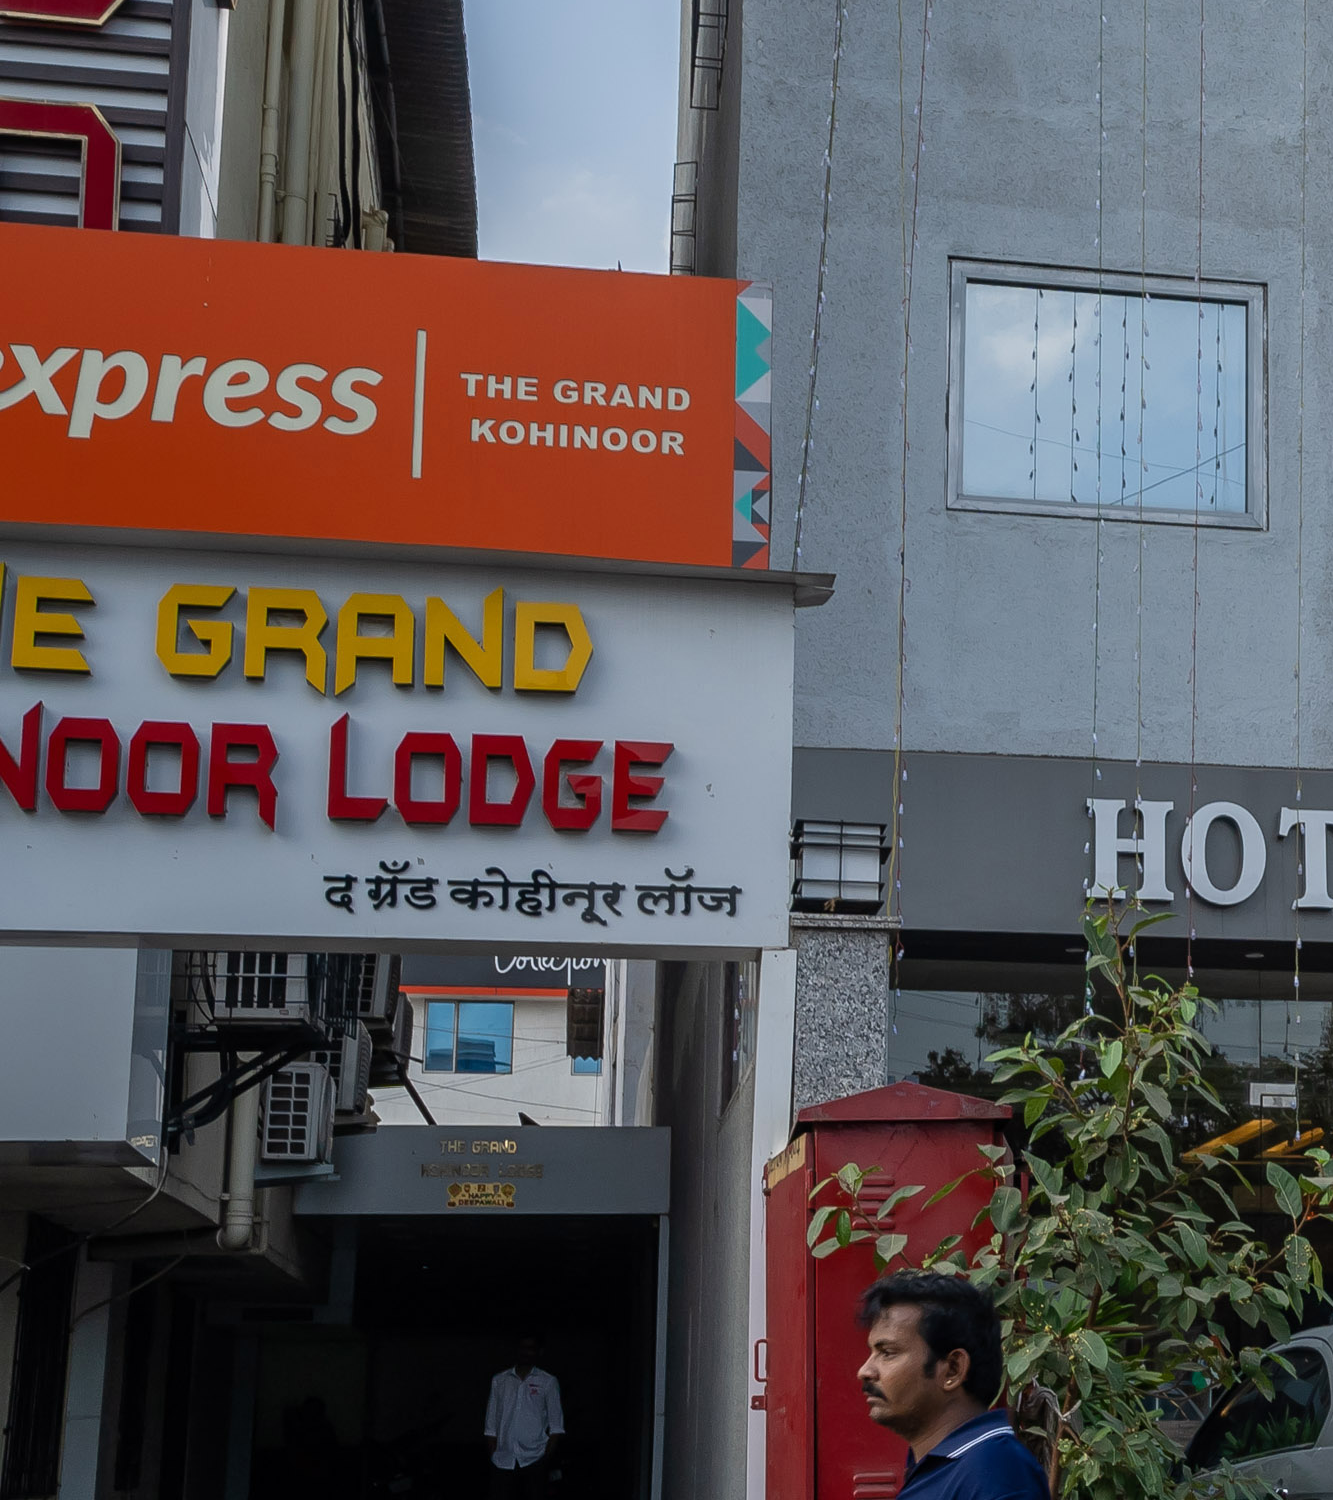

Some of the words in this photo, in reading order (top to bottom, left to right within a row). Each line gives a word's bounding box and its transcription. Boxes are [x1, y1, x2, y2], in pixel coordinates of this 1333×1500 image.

[460, 372, 539, 404] THE
[553, 379, 691, 413] GRAND
[469, 418, 686, 457] KOHINOOR
[155, 583, 595, 697] GRAND
[328, 712, 675, 834] LODGE
[322, 872, 358, 915] द
[447, 866, 626, 927] कोहीनूर
[635, 866, 743, 918] लॉज
[440, 1140, 466, 1154] THE
[471, 1140, 518, 1155] GRAND
